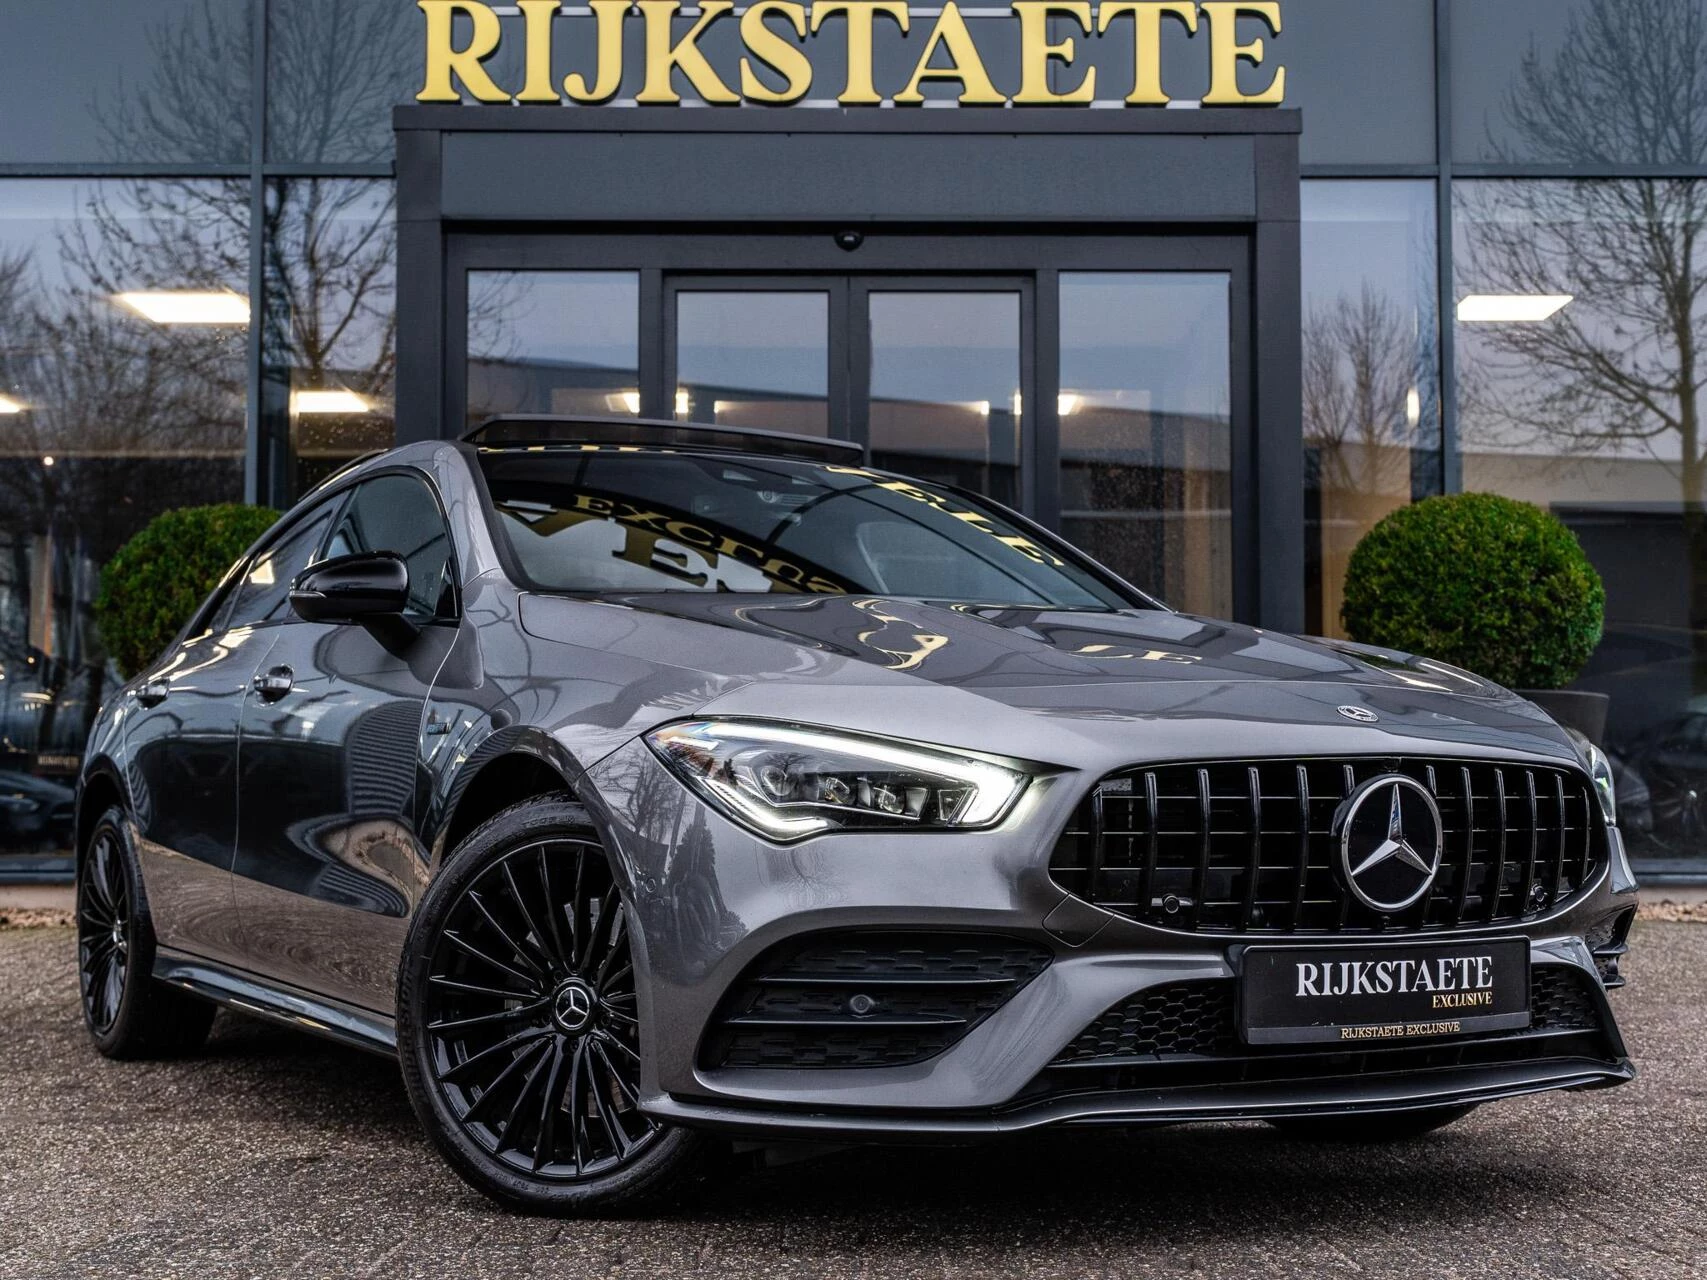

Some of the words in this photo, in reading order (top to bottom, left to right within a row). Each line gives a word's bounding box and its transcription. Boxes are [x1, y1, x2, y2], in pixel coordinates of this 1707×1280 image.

[415, 0, 1286, 106] RIJKSTAETE
[1295, 956, 1493, 996] RIJKSTAETE
[1432, 991, 1493, 1009] EXCLUSIVE
[1341, 1025, 1404, 1039] RIJKSTAETE
[1405, 1021, 1461, 1035] EXCLUSIVE
